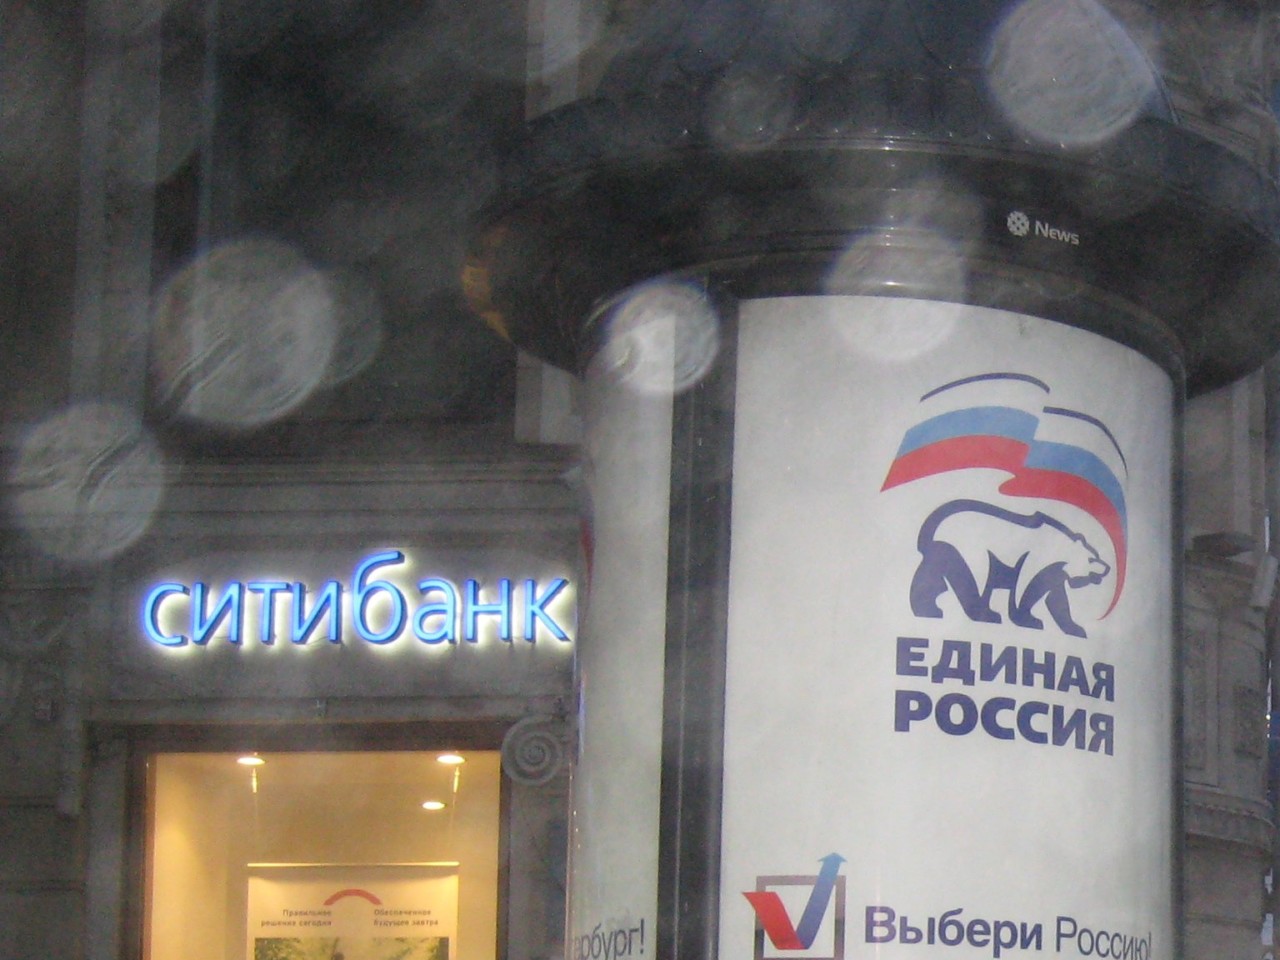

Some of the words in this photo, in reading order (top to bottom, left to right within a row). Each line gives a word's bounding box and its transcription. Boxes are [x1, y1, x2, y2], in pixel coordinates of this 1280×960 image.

[1035, 220, 1080, 246] News
[143, 550, 571, 647] ситибанк
[896, 637, 1115, 702] ЕДИНАЯ
[894, 690, 1114, 756] РОССИЯ
[865, 905, 1043, 959] Выбери
